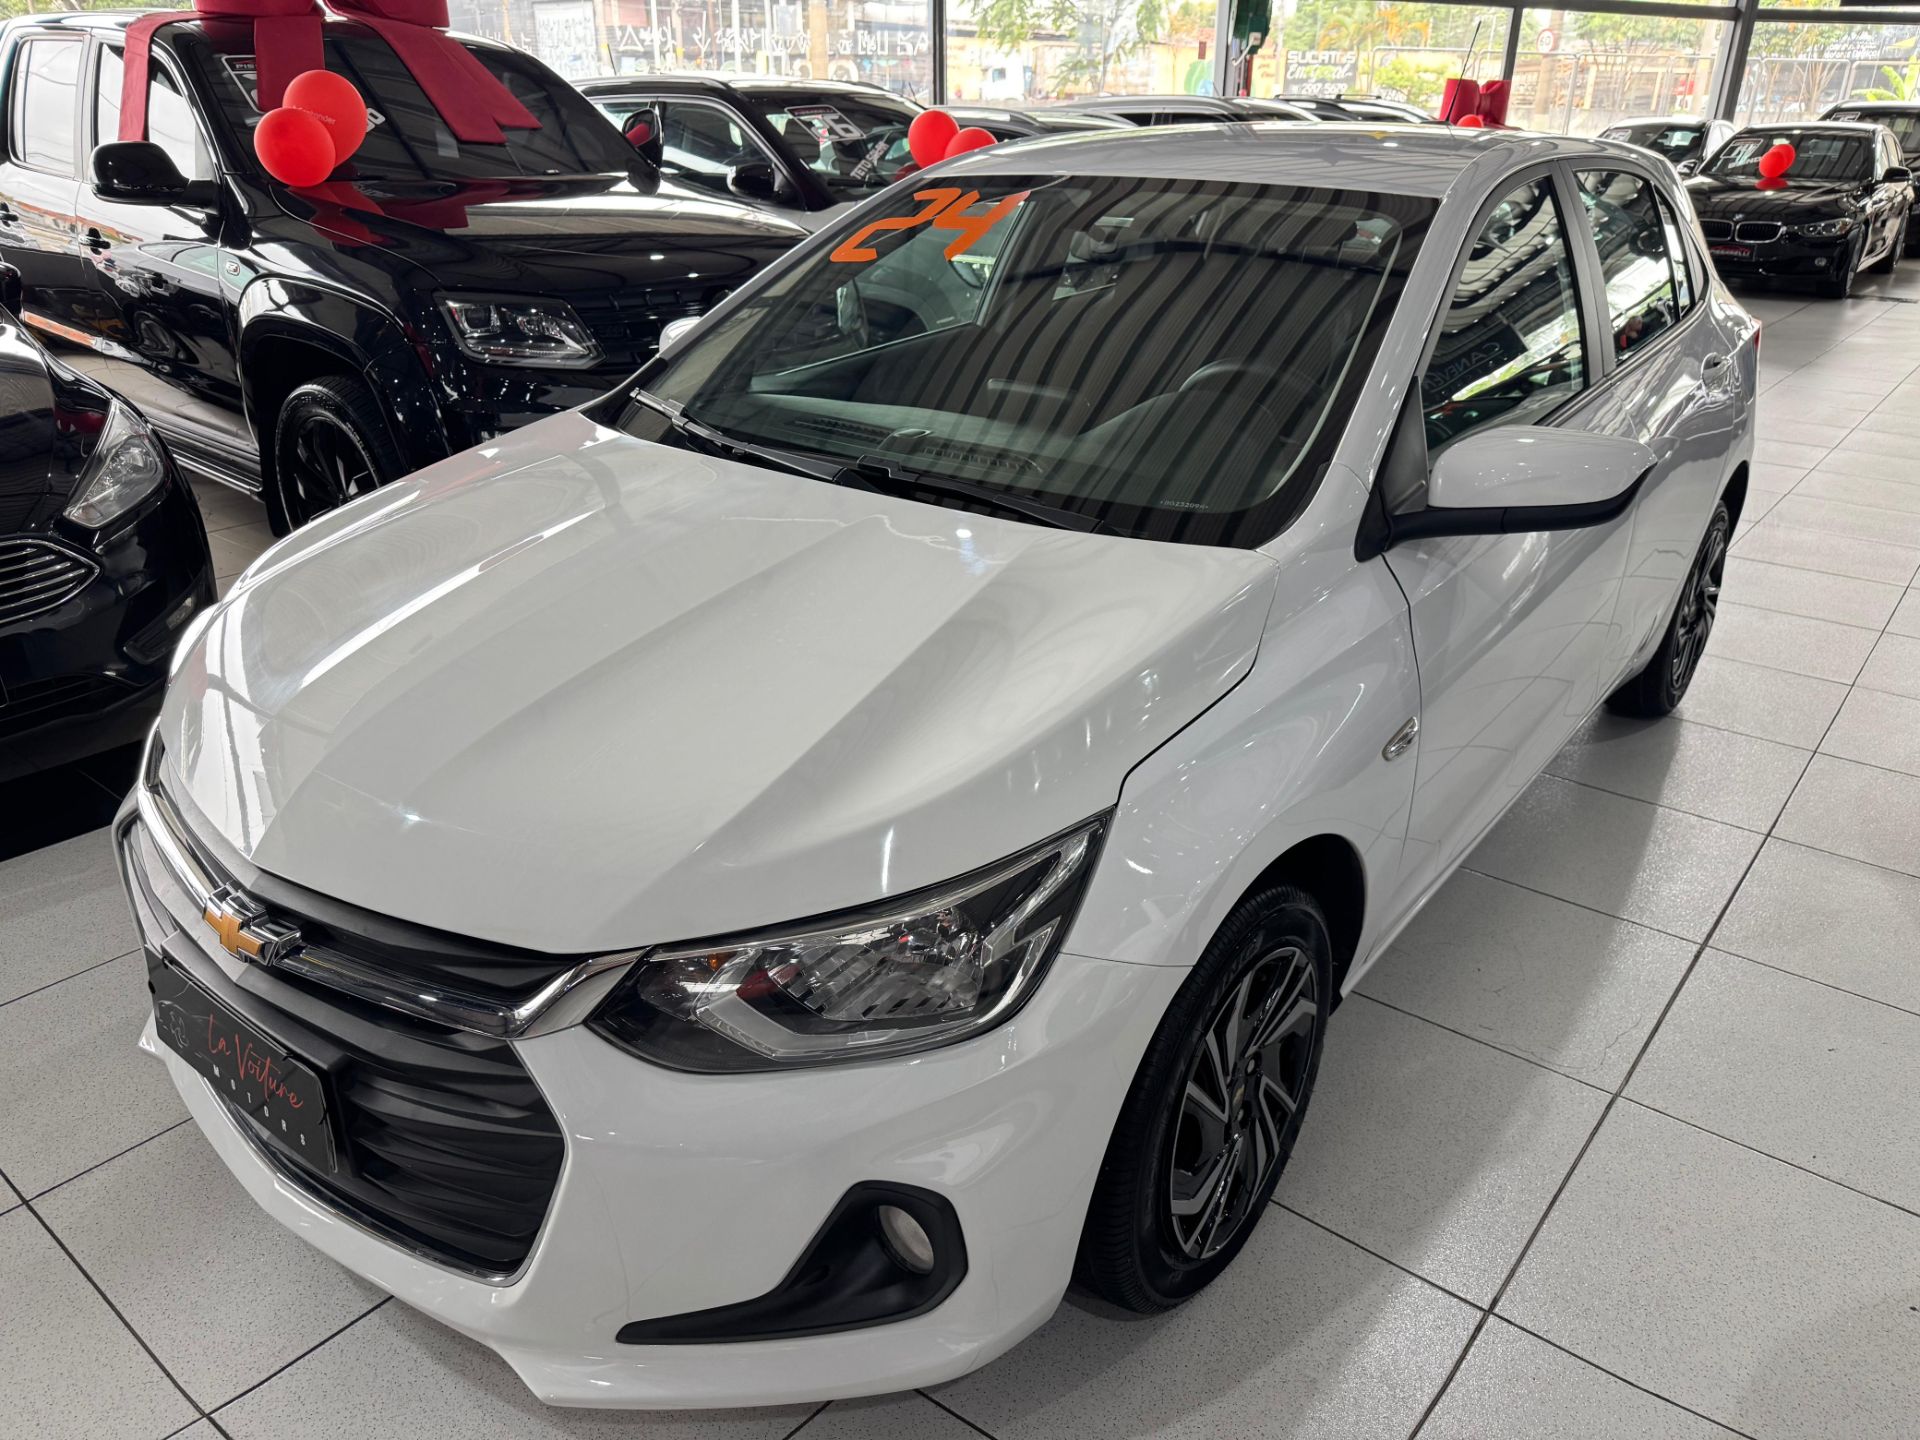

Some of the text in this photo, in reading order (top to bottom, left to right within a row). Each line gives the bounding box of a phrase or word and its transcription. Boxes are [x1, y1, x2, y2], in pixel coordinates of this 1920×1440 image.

[850, 159, 873, 179] TETO
[829, 187, 1032, 262] 24
[235, 1033, 304, 1109] Voiture
